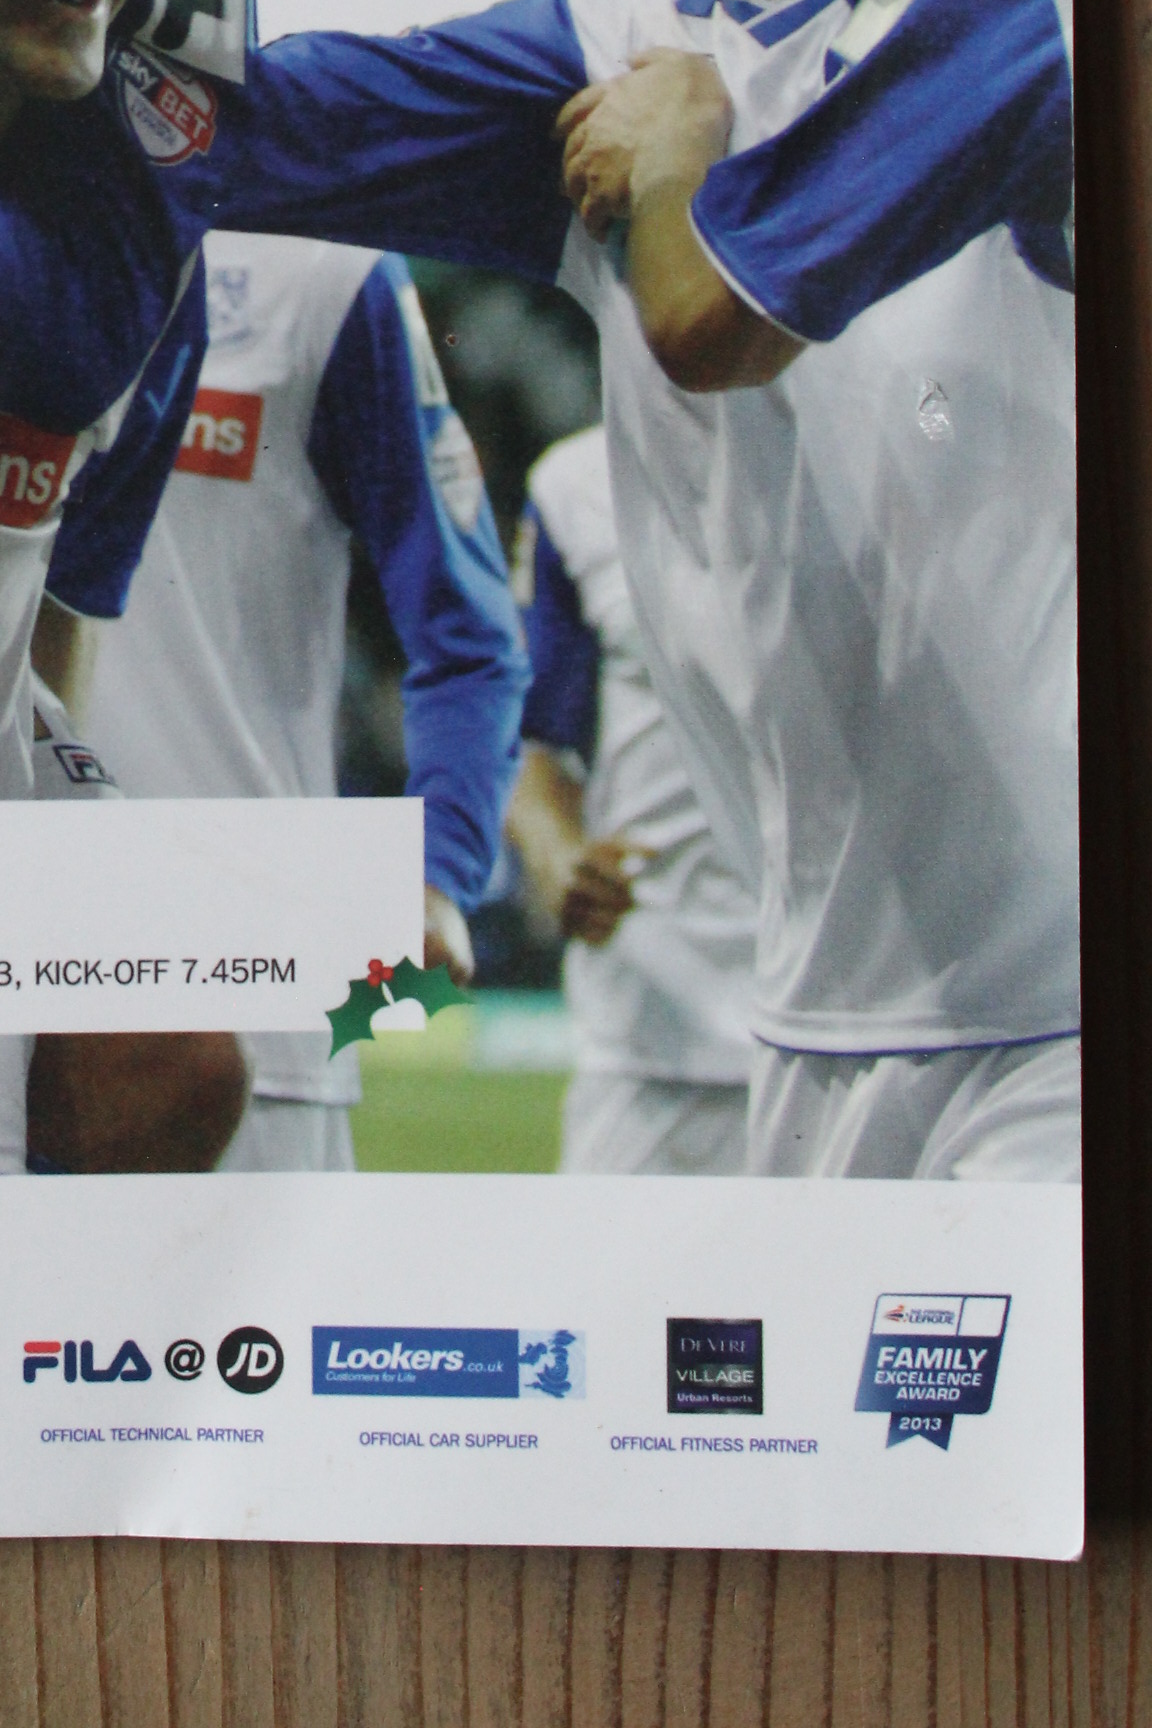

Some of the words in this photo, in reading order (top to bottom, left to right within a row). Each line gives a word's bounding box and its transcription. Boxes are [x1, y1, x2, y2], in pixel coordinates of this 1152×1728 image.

[160, 87, 209, 140] BET
[34, 958, 170, 987] KICK-OFF
[181, 957, 297, 985] 7.45PM
[23, 1339, 152, 1383] FILA
[164, 1338, 205, 1381] @
[224, 1343, 278, 1377] JD
[326, 1340, 504, 1372] Lookers.co.uk
[877, 1346, 988, 1372] FAMILY
[325, 1371, 381, 1382] Customers
[382, 1371, 395, 1383] for
[397, 1372, 416, 1383] Life
[676, 1368, 754, 1384] VILLAGE
[874, 1371, 983, 1387] EXCELLENCE
[676, 1392, 709, 1403] Urban
[711, 1393, 753, 1403] Resorts
[896, 1386, 961, 1402] AWARD
[898, 1416, 943, 1431] 2013
[40, 1427, 106, 1443] OFFICIAL
[110, 1426, 192, 1443] TECHNICAL
[197, 1427, 265, 1443] PARTNER
[359, 1431, 425, 1448] OFFICIAL
[429, 1432, 460, 1448] CAR
[464, 1432, 539, 1449] SUPPLIER
[610, 1435, 676, 1452] OFFICIAL
[681, 1437, 744, 1452] FITNESS
[749, 1438, 818, 1454] PARTNER
